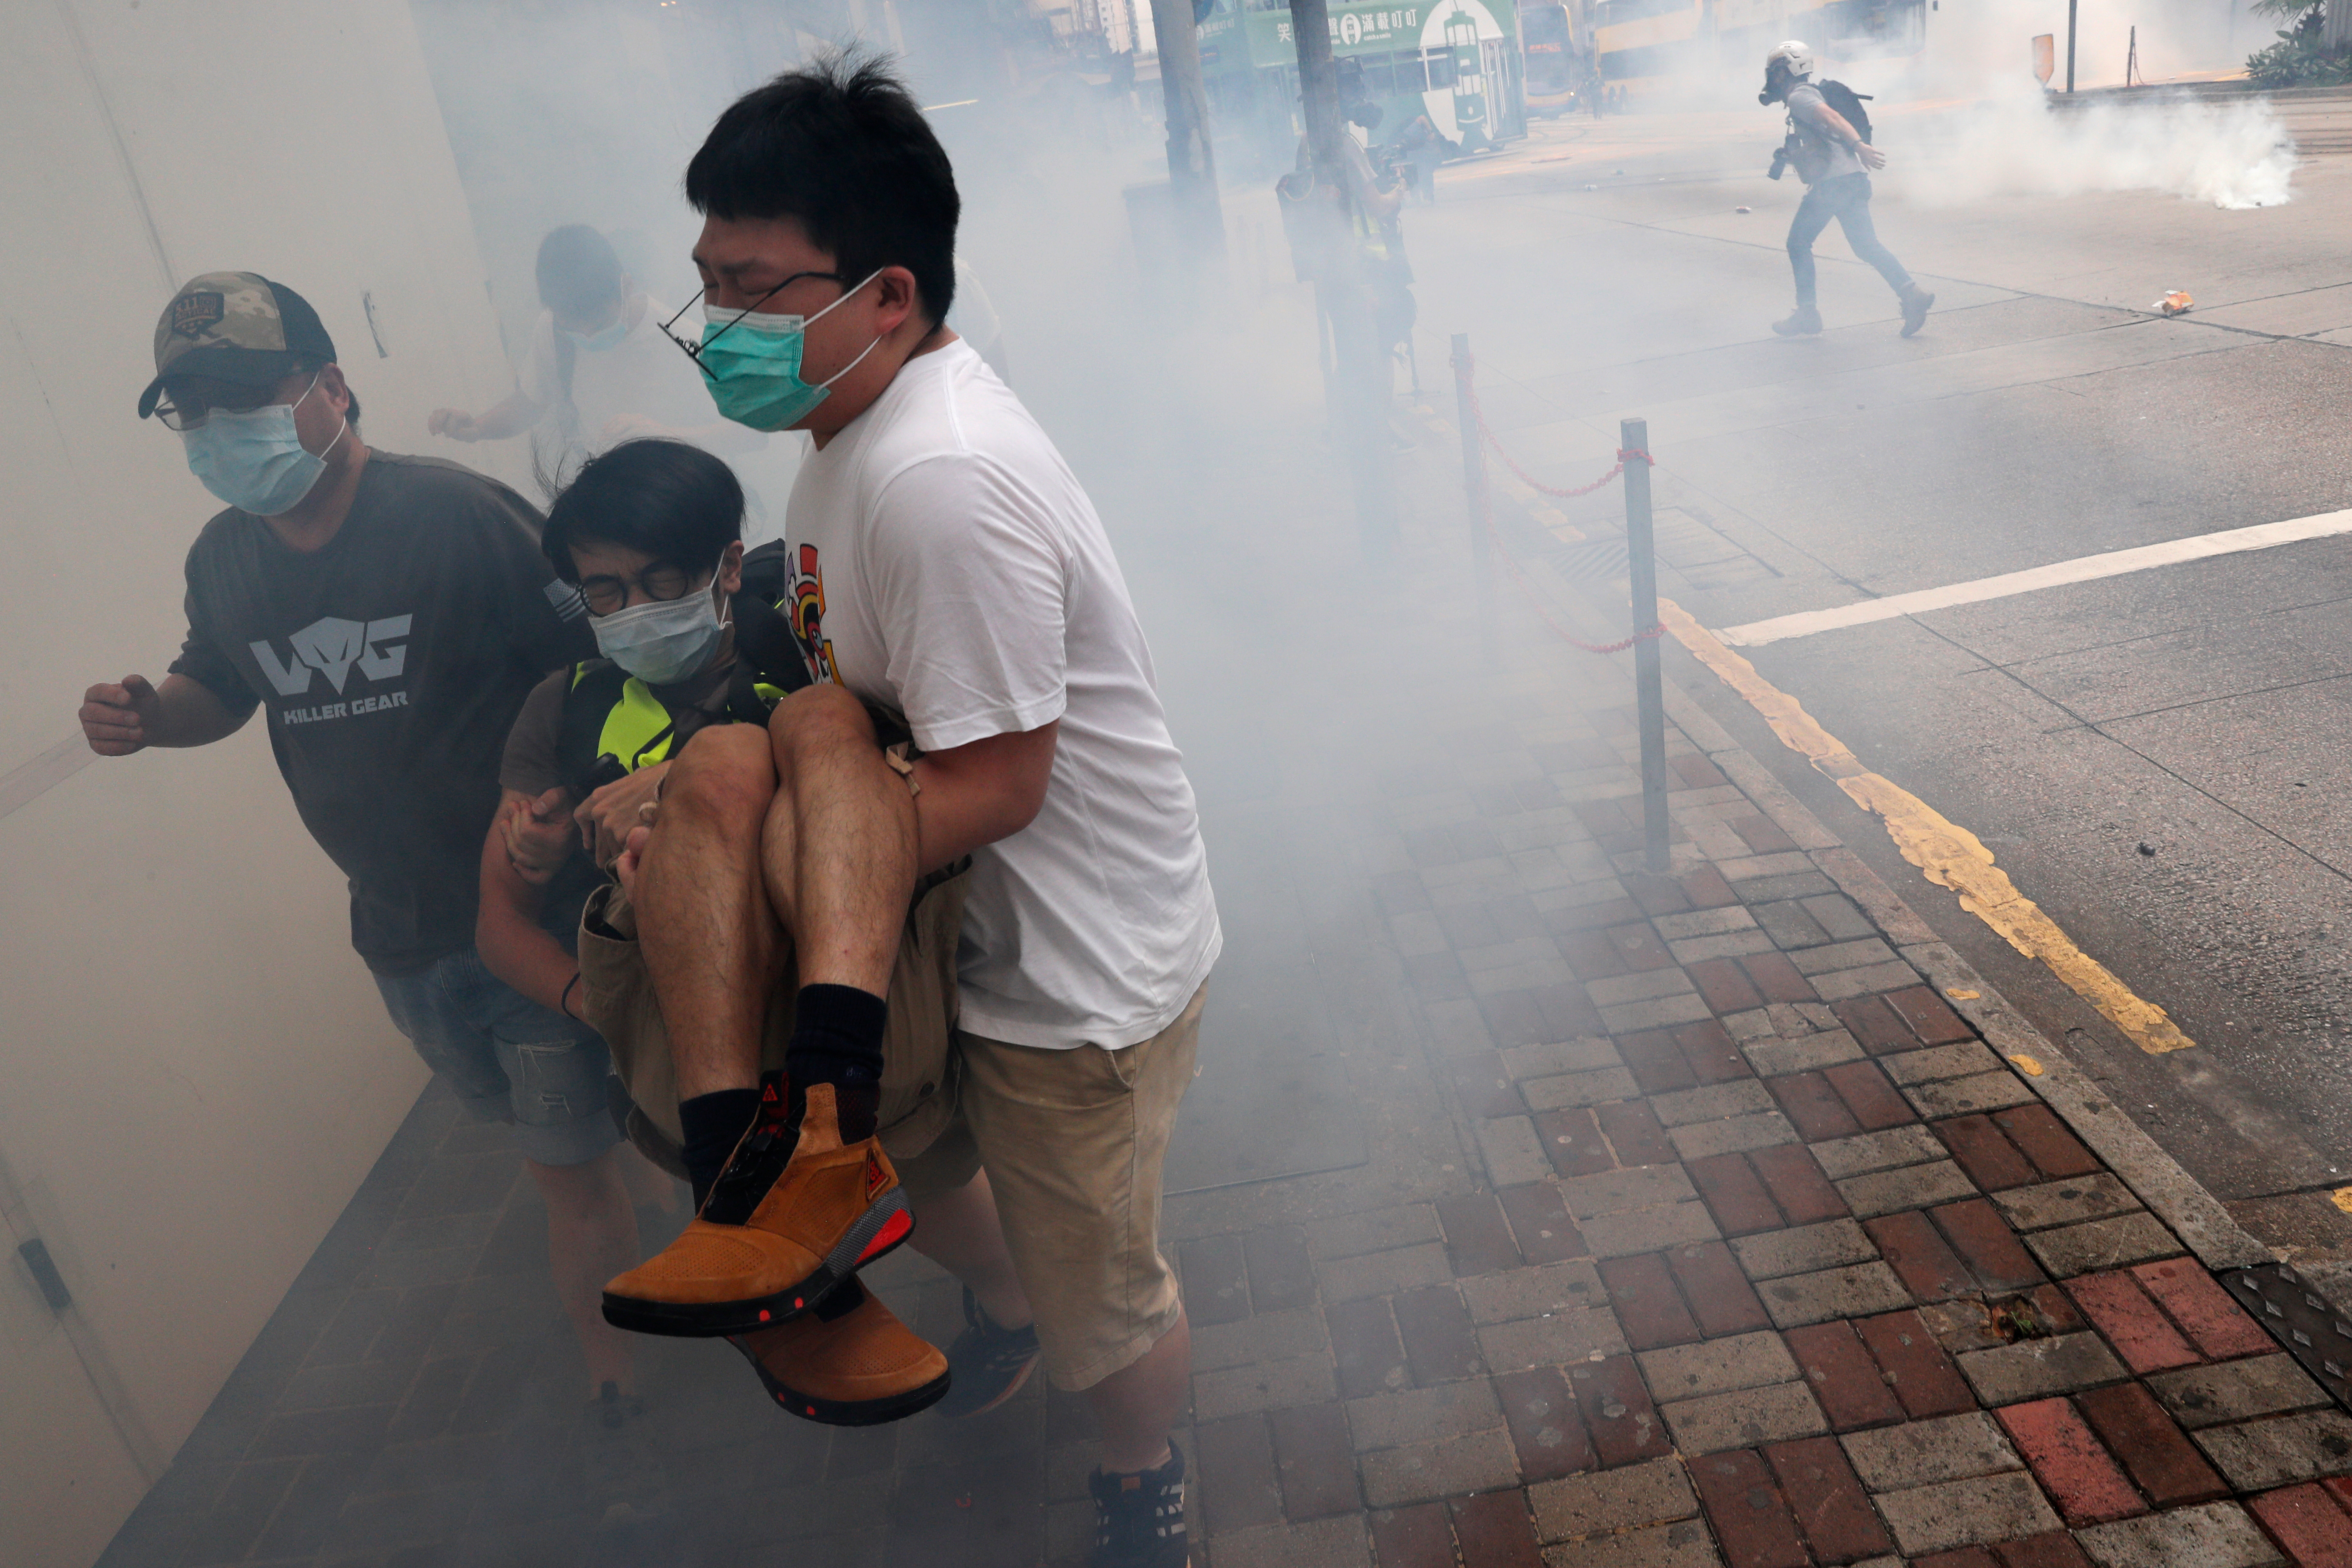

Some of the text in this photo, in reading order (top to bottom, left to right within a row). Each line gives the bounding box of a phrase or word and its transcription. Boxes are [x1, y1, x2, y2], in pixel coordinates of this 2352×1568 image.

[1361, 9, 1417, 32] 滿載叮叮
[284, 691, 409, 725] KILLER GEAR
